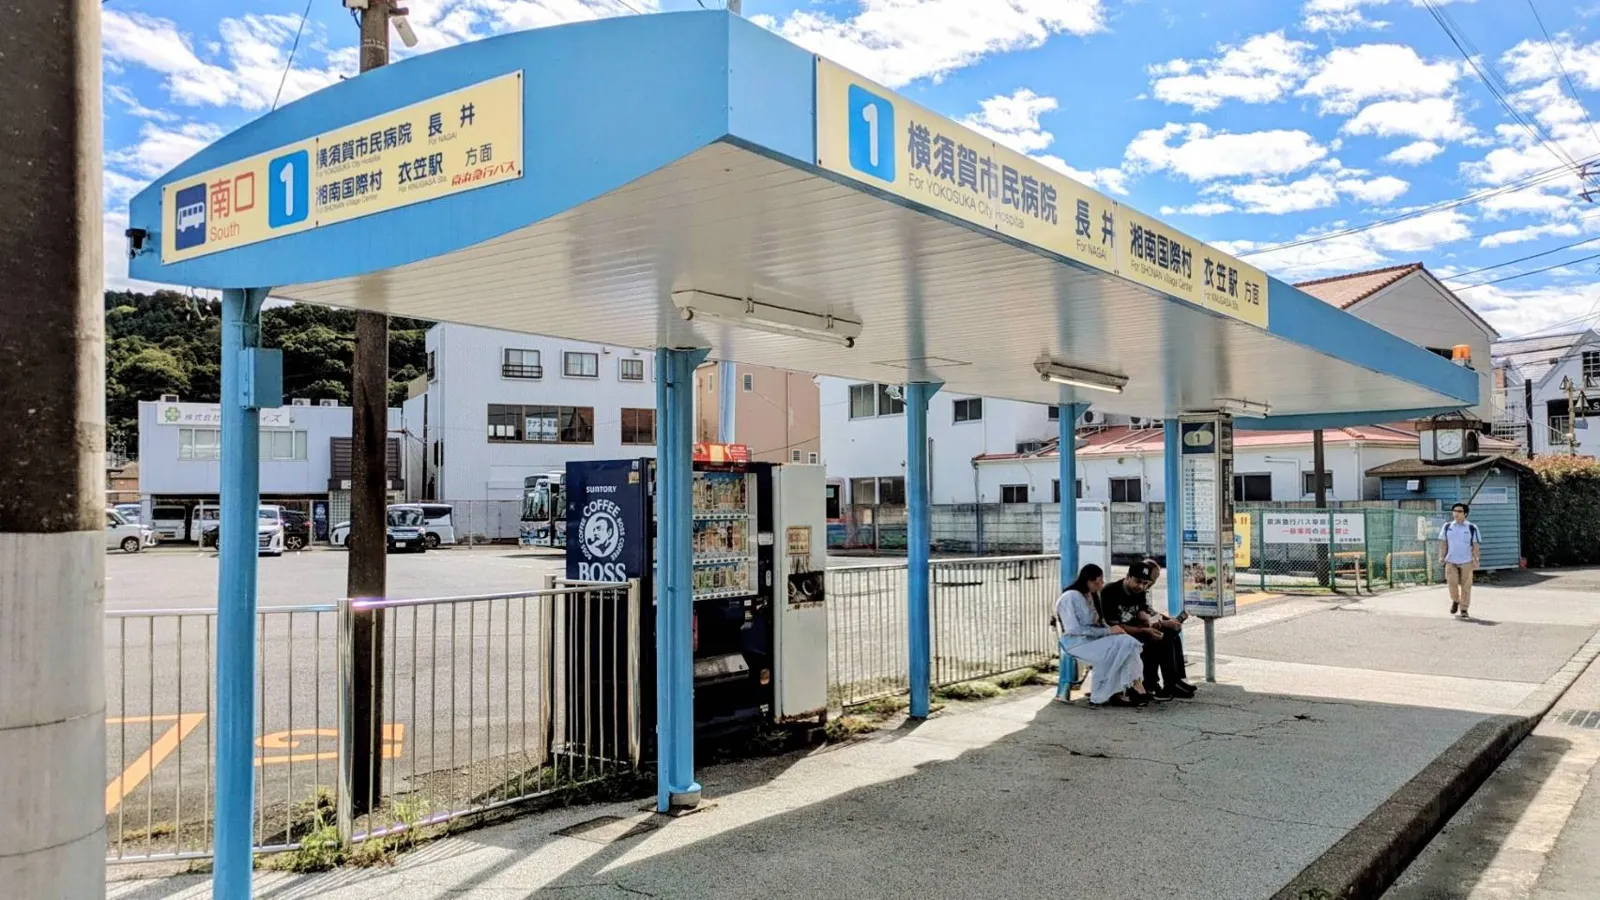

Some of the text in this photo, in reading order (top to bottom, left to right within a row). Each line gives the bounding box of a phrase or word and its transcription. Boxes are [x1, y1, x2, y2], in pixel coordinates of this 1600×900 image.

[316, 122, 412, 169] 横須賀市民病院
[428, 138, 437, 146] For
[862, 103, 879, 167] 1
[316, 143, 492, 206] 湘南国際村 衣笠駅 方面
[451, 160, 516, 187] 京浜急行バス
[907, 120, 1058, 226] 横須賀市民病院
[209, 172, 254, 220] 南口
[280, 162, 293, 216] 1
[908, 173, 1024, 229] For YOKOSUKA City Hospital
[209, 221, 240, 242] South
[1076, 239, 1087, 252] For
[1130, 220, 1260, 306] 湘南国際村 衣笠駅 方面
[1131, 259, 1140, 272] For
[1141, 263, 1162, 281] SHONAN
[1194, 433, 1200, 443] 1
[586, 485, 617, 494] SUNTORY
[583, 499, 621, 518] COFFEE
[578, 517, 587, 544] COFFEE
[610, 538, 625, 561] COFFEE
[578, 562, 627, 583] BOSS
